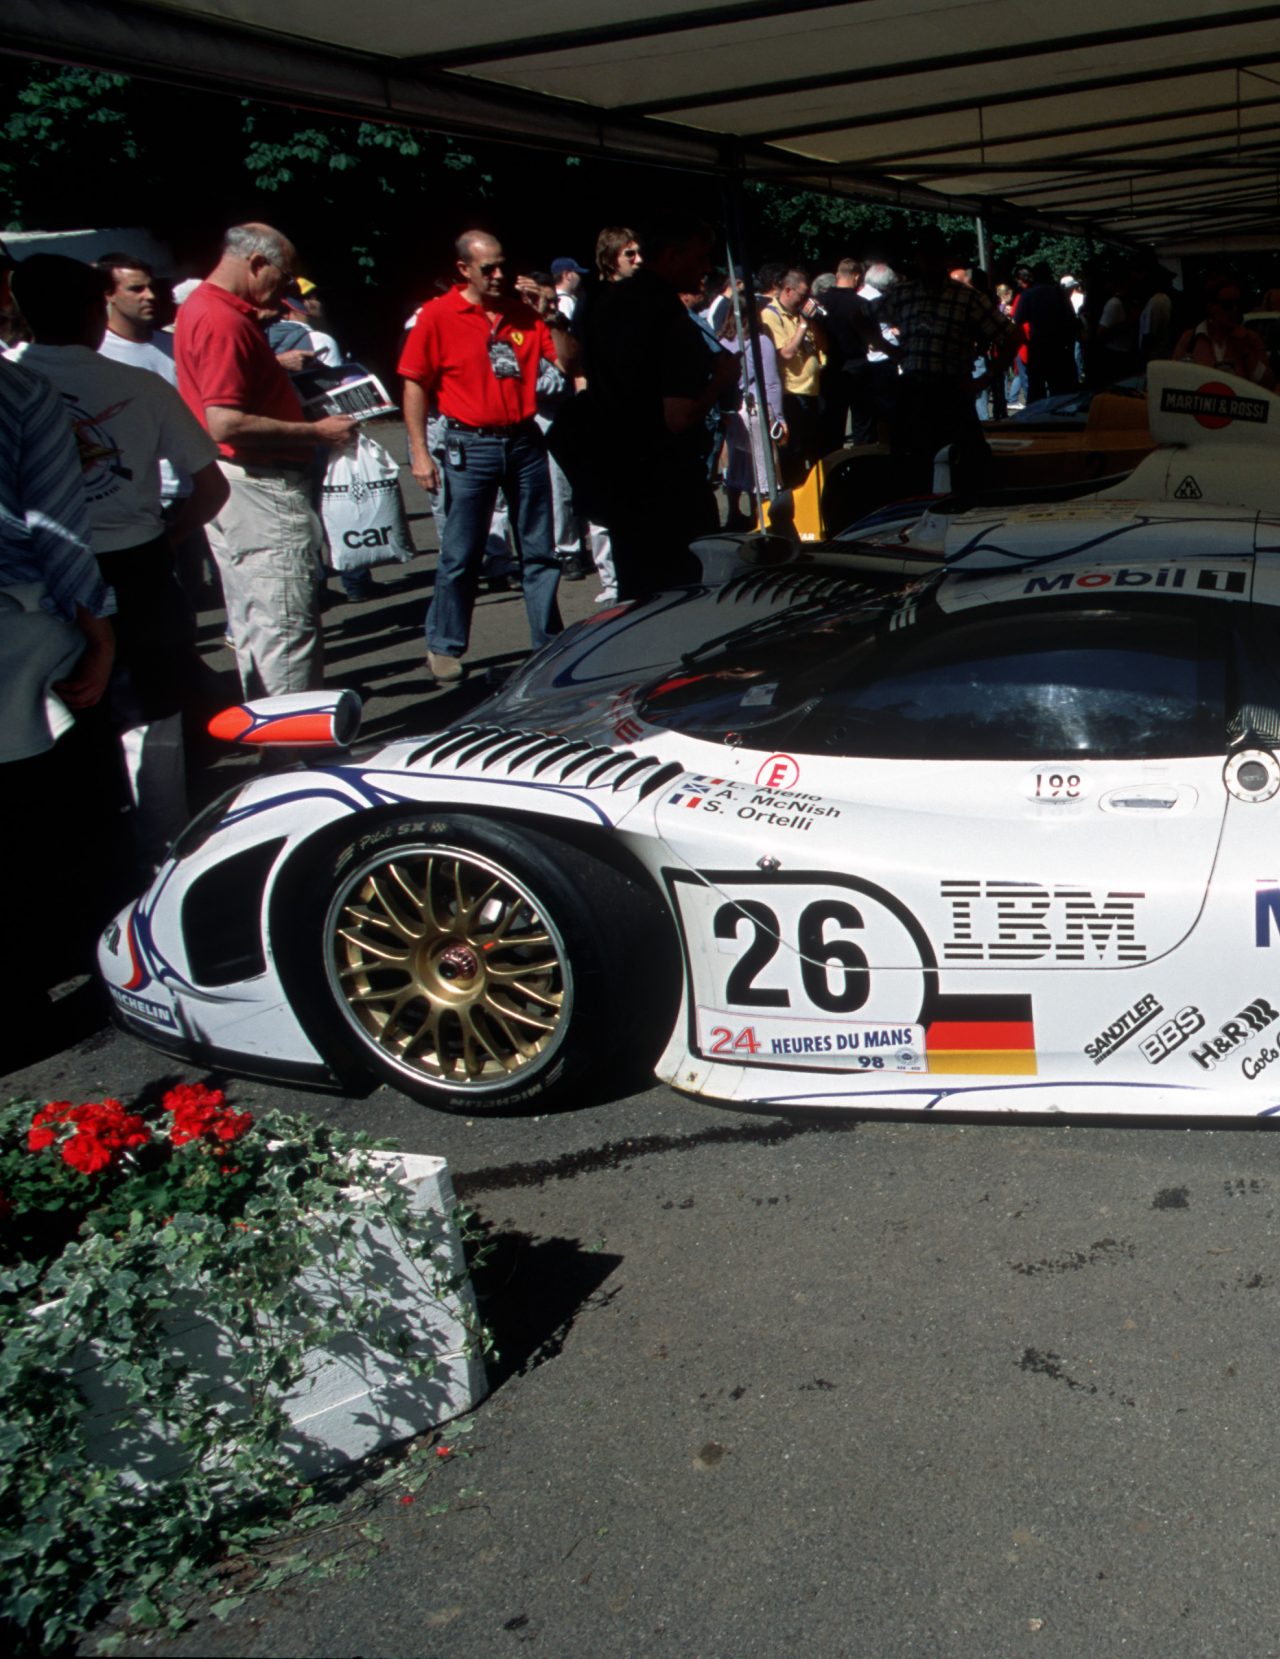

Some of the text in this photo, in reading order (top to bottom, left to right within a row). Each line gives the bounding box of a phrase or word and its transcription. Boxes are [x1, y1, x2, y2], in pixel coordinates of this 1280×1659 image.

[1165, 392, 1266, 418] MARTINI & ROSSI
[343, 525, 392, 549] car
[1023, 568, 1186, 593] Mobil
[766, 763, 788, 787] E
[703, 800, 814, 831] S. Ortelli
[715, 790, 841, 818] A. McNish
[397, 822, 426, 836] SX
[940, 881, 1147, 960] IBM
[713, 899, 871, 1013] 26
[1083, 992, 1160, 1059] SANDTLER
[1138, 1005, 1206, 1065] BBS
[710, 1026, 913, 1054] 24 HEURES DU MANS
[1190, 1020, 1252, 1070] H&R
[858, 1056, 885, 1069] 98
